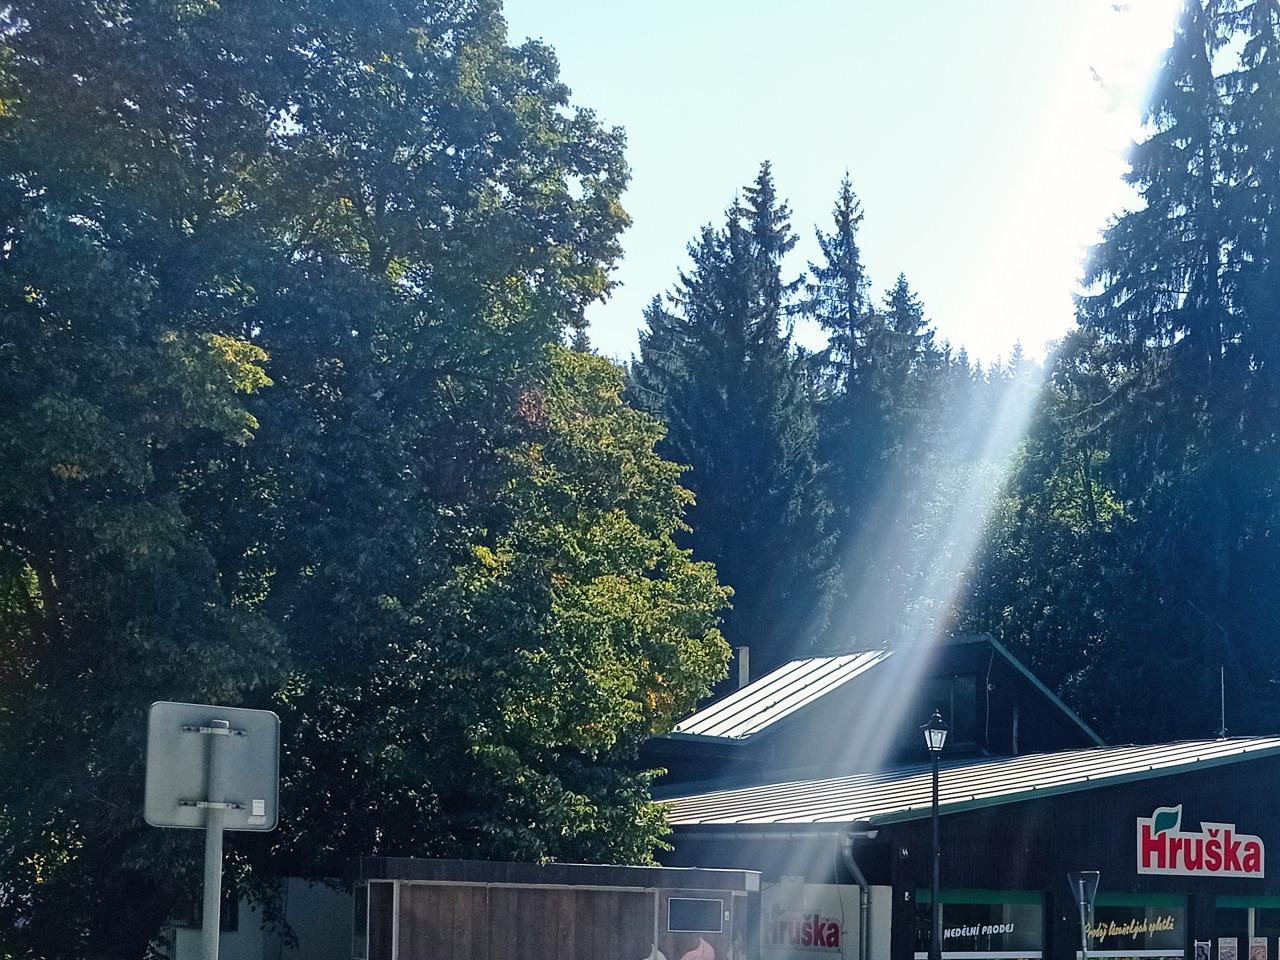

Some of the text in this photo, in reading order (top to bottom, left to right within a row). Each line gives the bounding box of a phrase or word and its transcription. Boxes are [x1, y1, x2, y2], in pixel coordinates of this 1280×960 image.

[1142, 824, 1261, 873] Hruška
[944, 923, 1015, 939] NEDĚLNÍ PRODEJ
